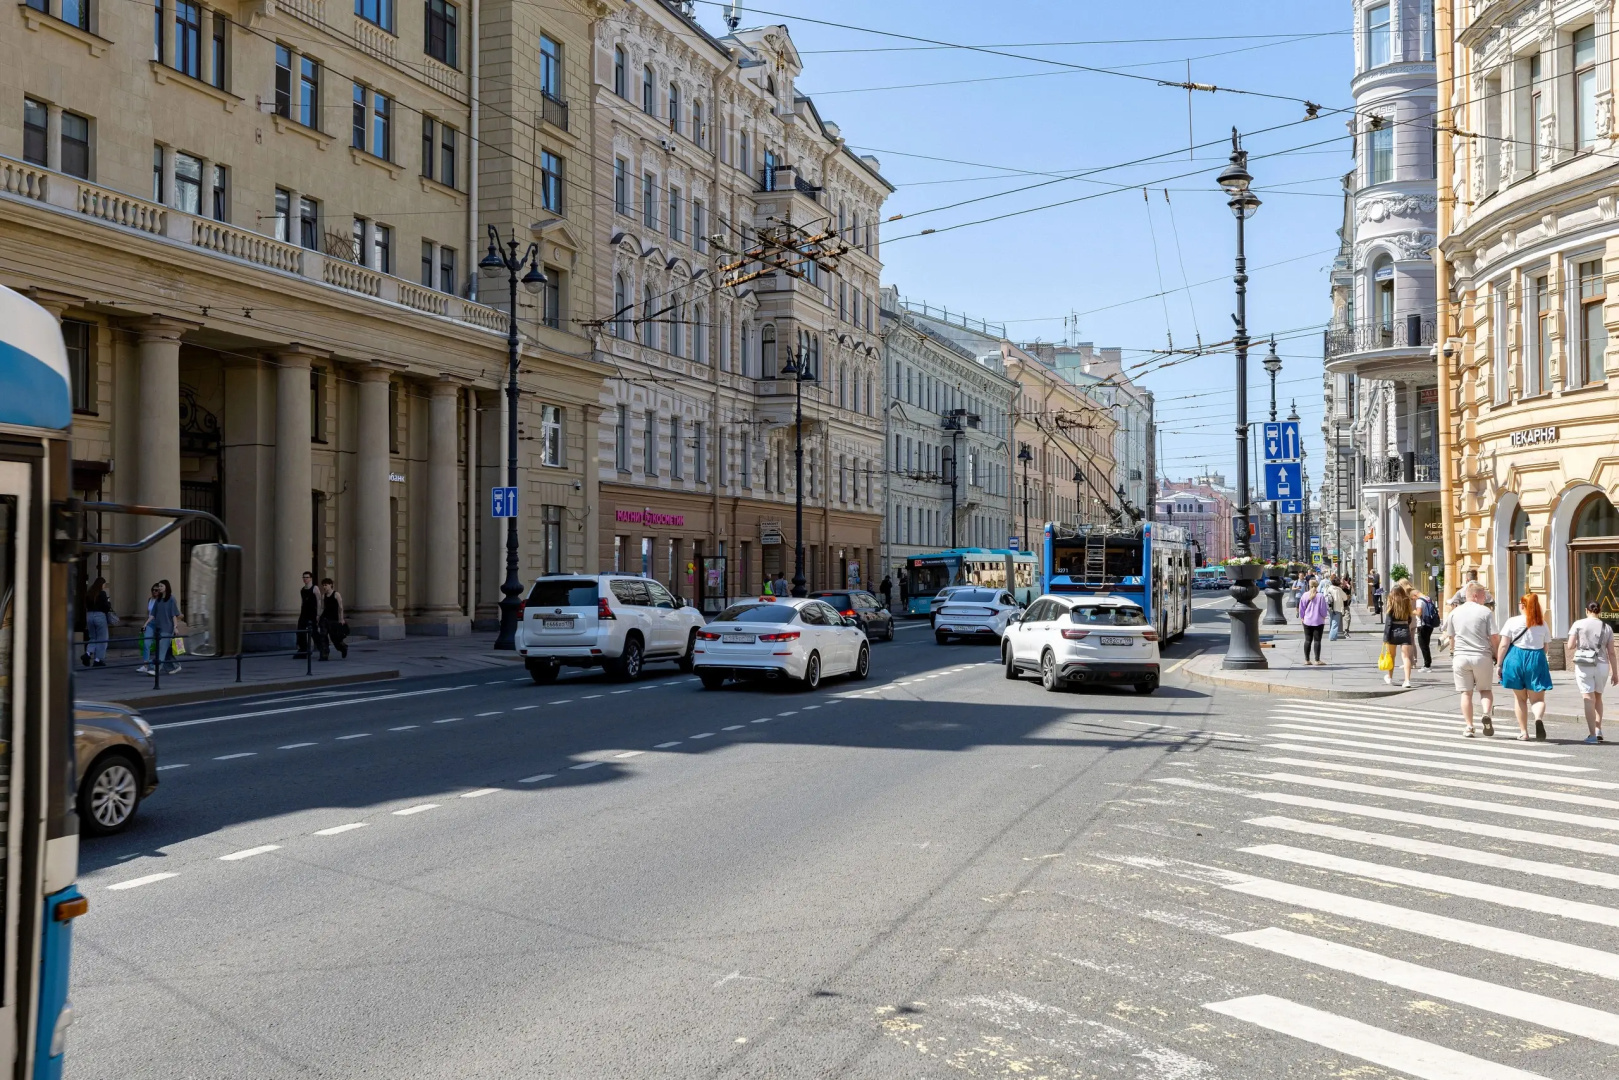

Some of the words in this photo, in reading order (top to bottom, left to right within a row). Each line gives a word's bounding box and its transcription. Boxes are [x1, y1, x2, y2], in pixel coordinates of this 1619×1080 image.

[1510, 426, 1556, 446] ПЕКАРНЯ
[616, 510, 643, 523] МАГНИТ
[652, 513, 684, 526] КОСМЕТИК
